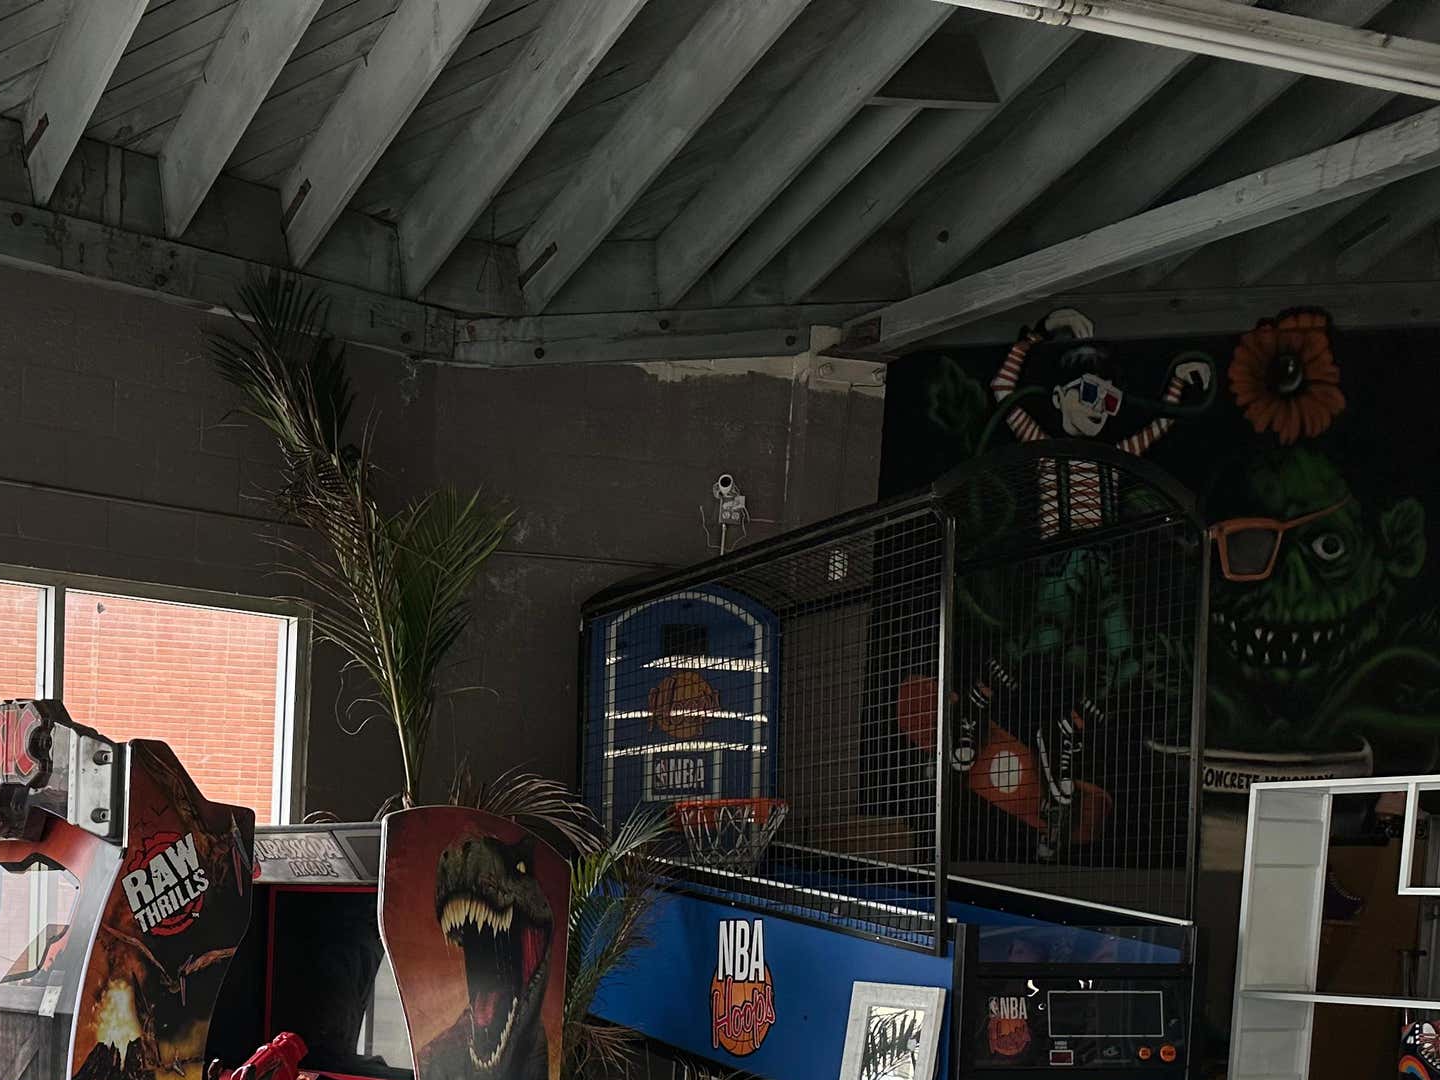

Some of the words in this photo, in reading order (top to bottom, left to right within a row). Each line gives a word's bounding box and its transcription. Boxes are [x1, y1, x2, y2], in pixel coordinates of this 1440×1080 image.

[669, 758, 705, 789] NBA
[122, 833, 200, 913] RAW
[134, 868, 209, 933] THRILLS
[289, 862, 339, 877] ARCADE
[718, 919, 765, 982] NBA
[713, 976, 776, 1048] Hoops
[1000, 997, 1028, 1020] NBA
